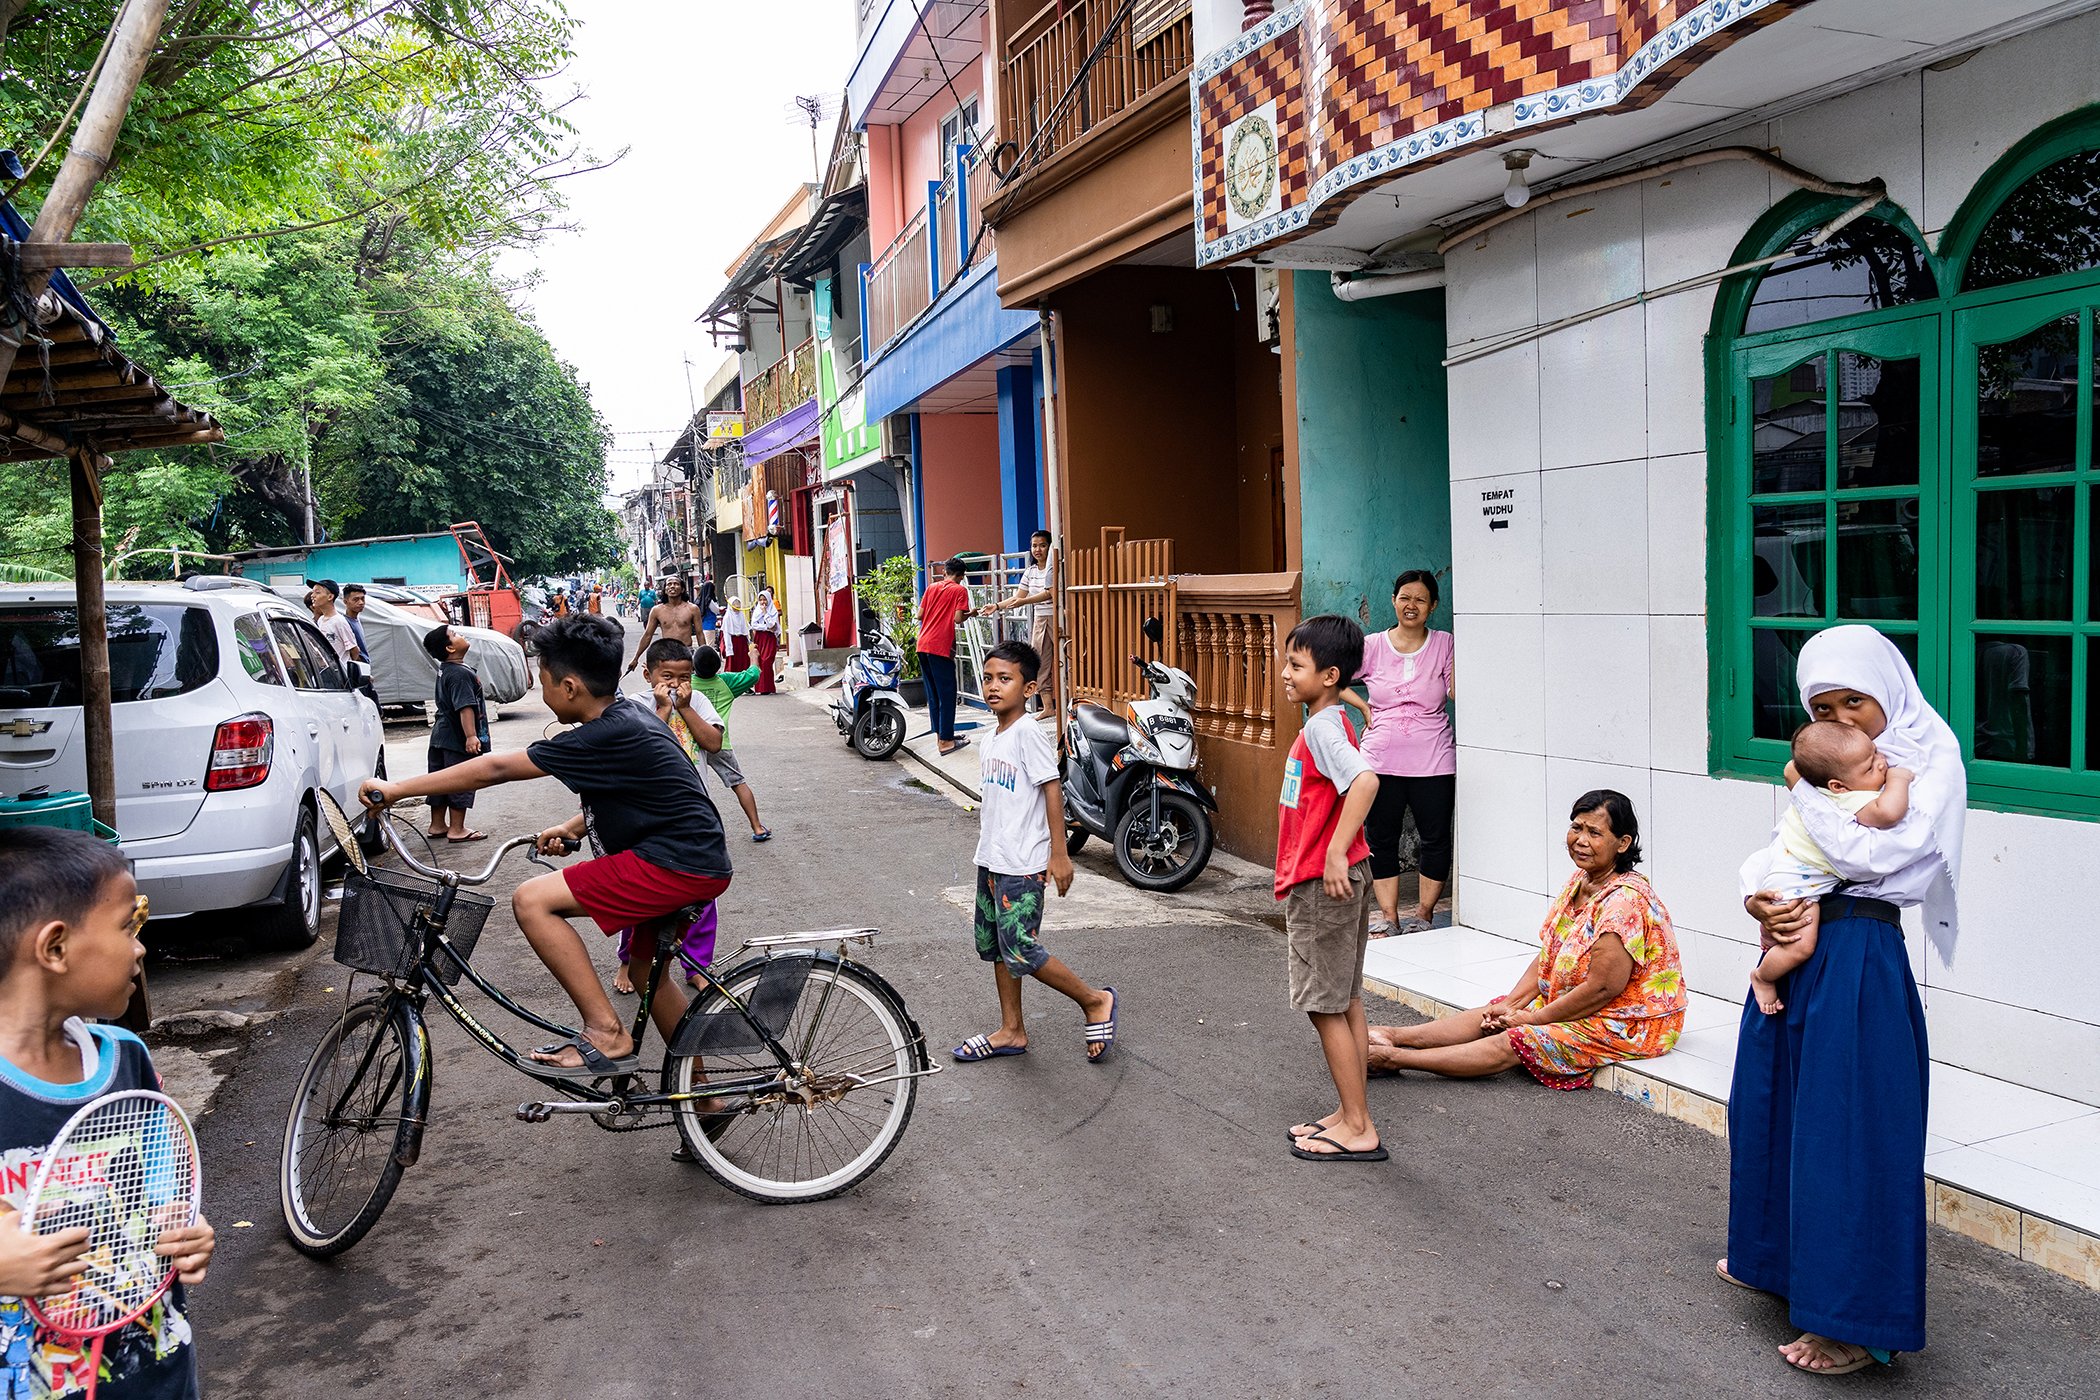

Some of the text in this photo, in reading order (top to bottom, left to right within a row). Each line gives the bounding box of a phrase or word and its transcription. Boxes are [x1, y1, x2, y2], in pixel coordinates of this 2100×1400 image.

[1481, 489, 1514, 501] TEMPAT
[1482, 504, 1513, 516] WUDHU
[1149, 717, 1155, 726] B
[142, 779, 197, 790] SPIN LTZ
